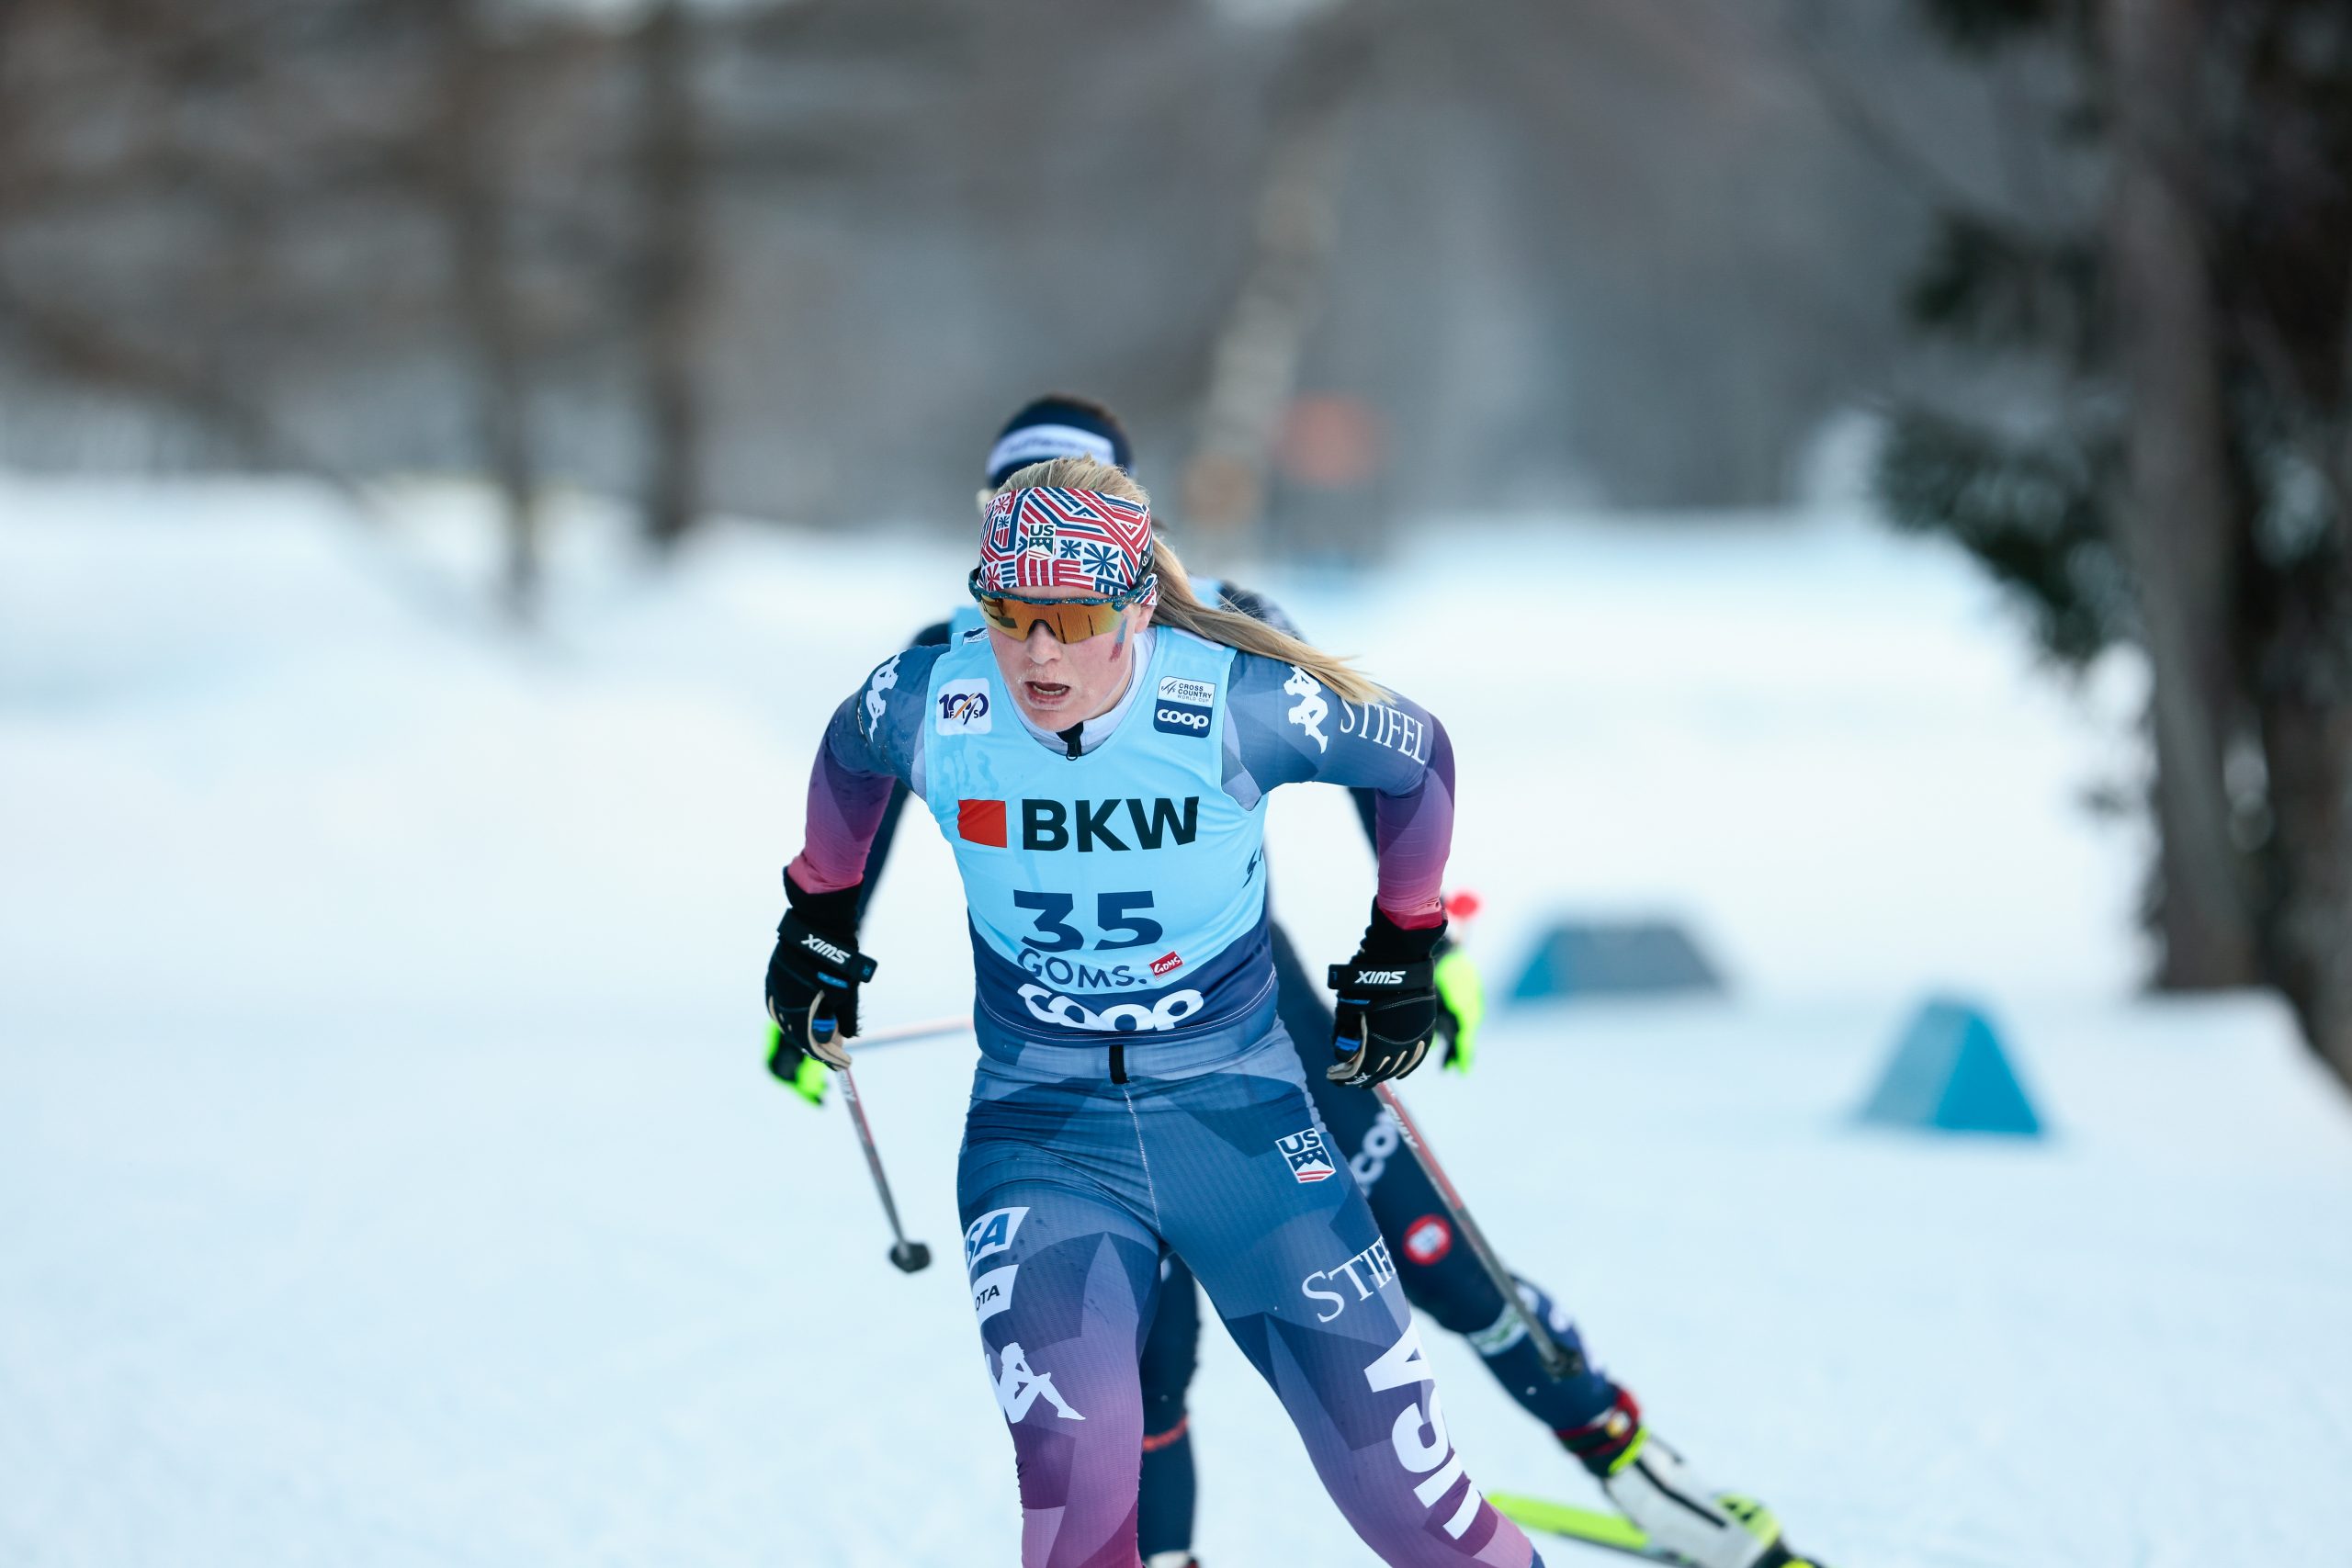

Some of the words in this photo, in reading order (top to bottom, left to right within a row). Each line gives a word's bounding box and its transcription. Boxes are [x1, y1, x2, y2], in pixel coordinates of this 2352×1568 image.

[1030, 525, 1055, 536] US
[1178, 689, 1212, 698] COUNTRY
[1179, 682, 1204, 692] CROSS
[1157, 708, 1209, 729] coop
[1340, 698, 1425, 764] STIFEL
[1022, 795, 1199, 852] BKW
[1013, 889, 1163, 953] 35
[1017, 983, 1204, 1032] coop
[1279, 1130, 1320, 1155] US
[966, 1213, 1011, 1269] SA
[1302, 1234, 1396, 1323] STIF
[976, 1285, 1000, 1311] OTA
